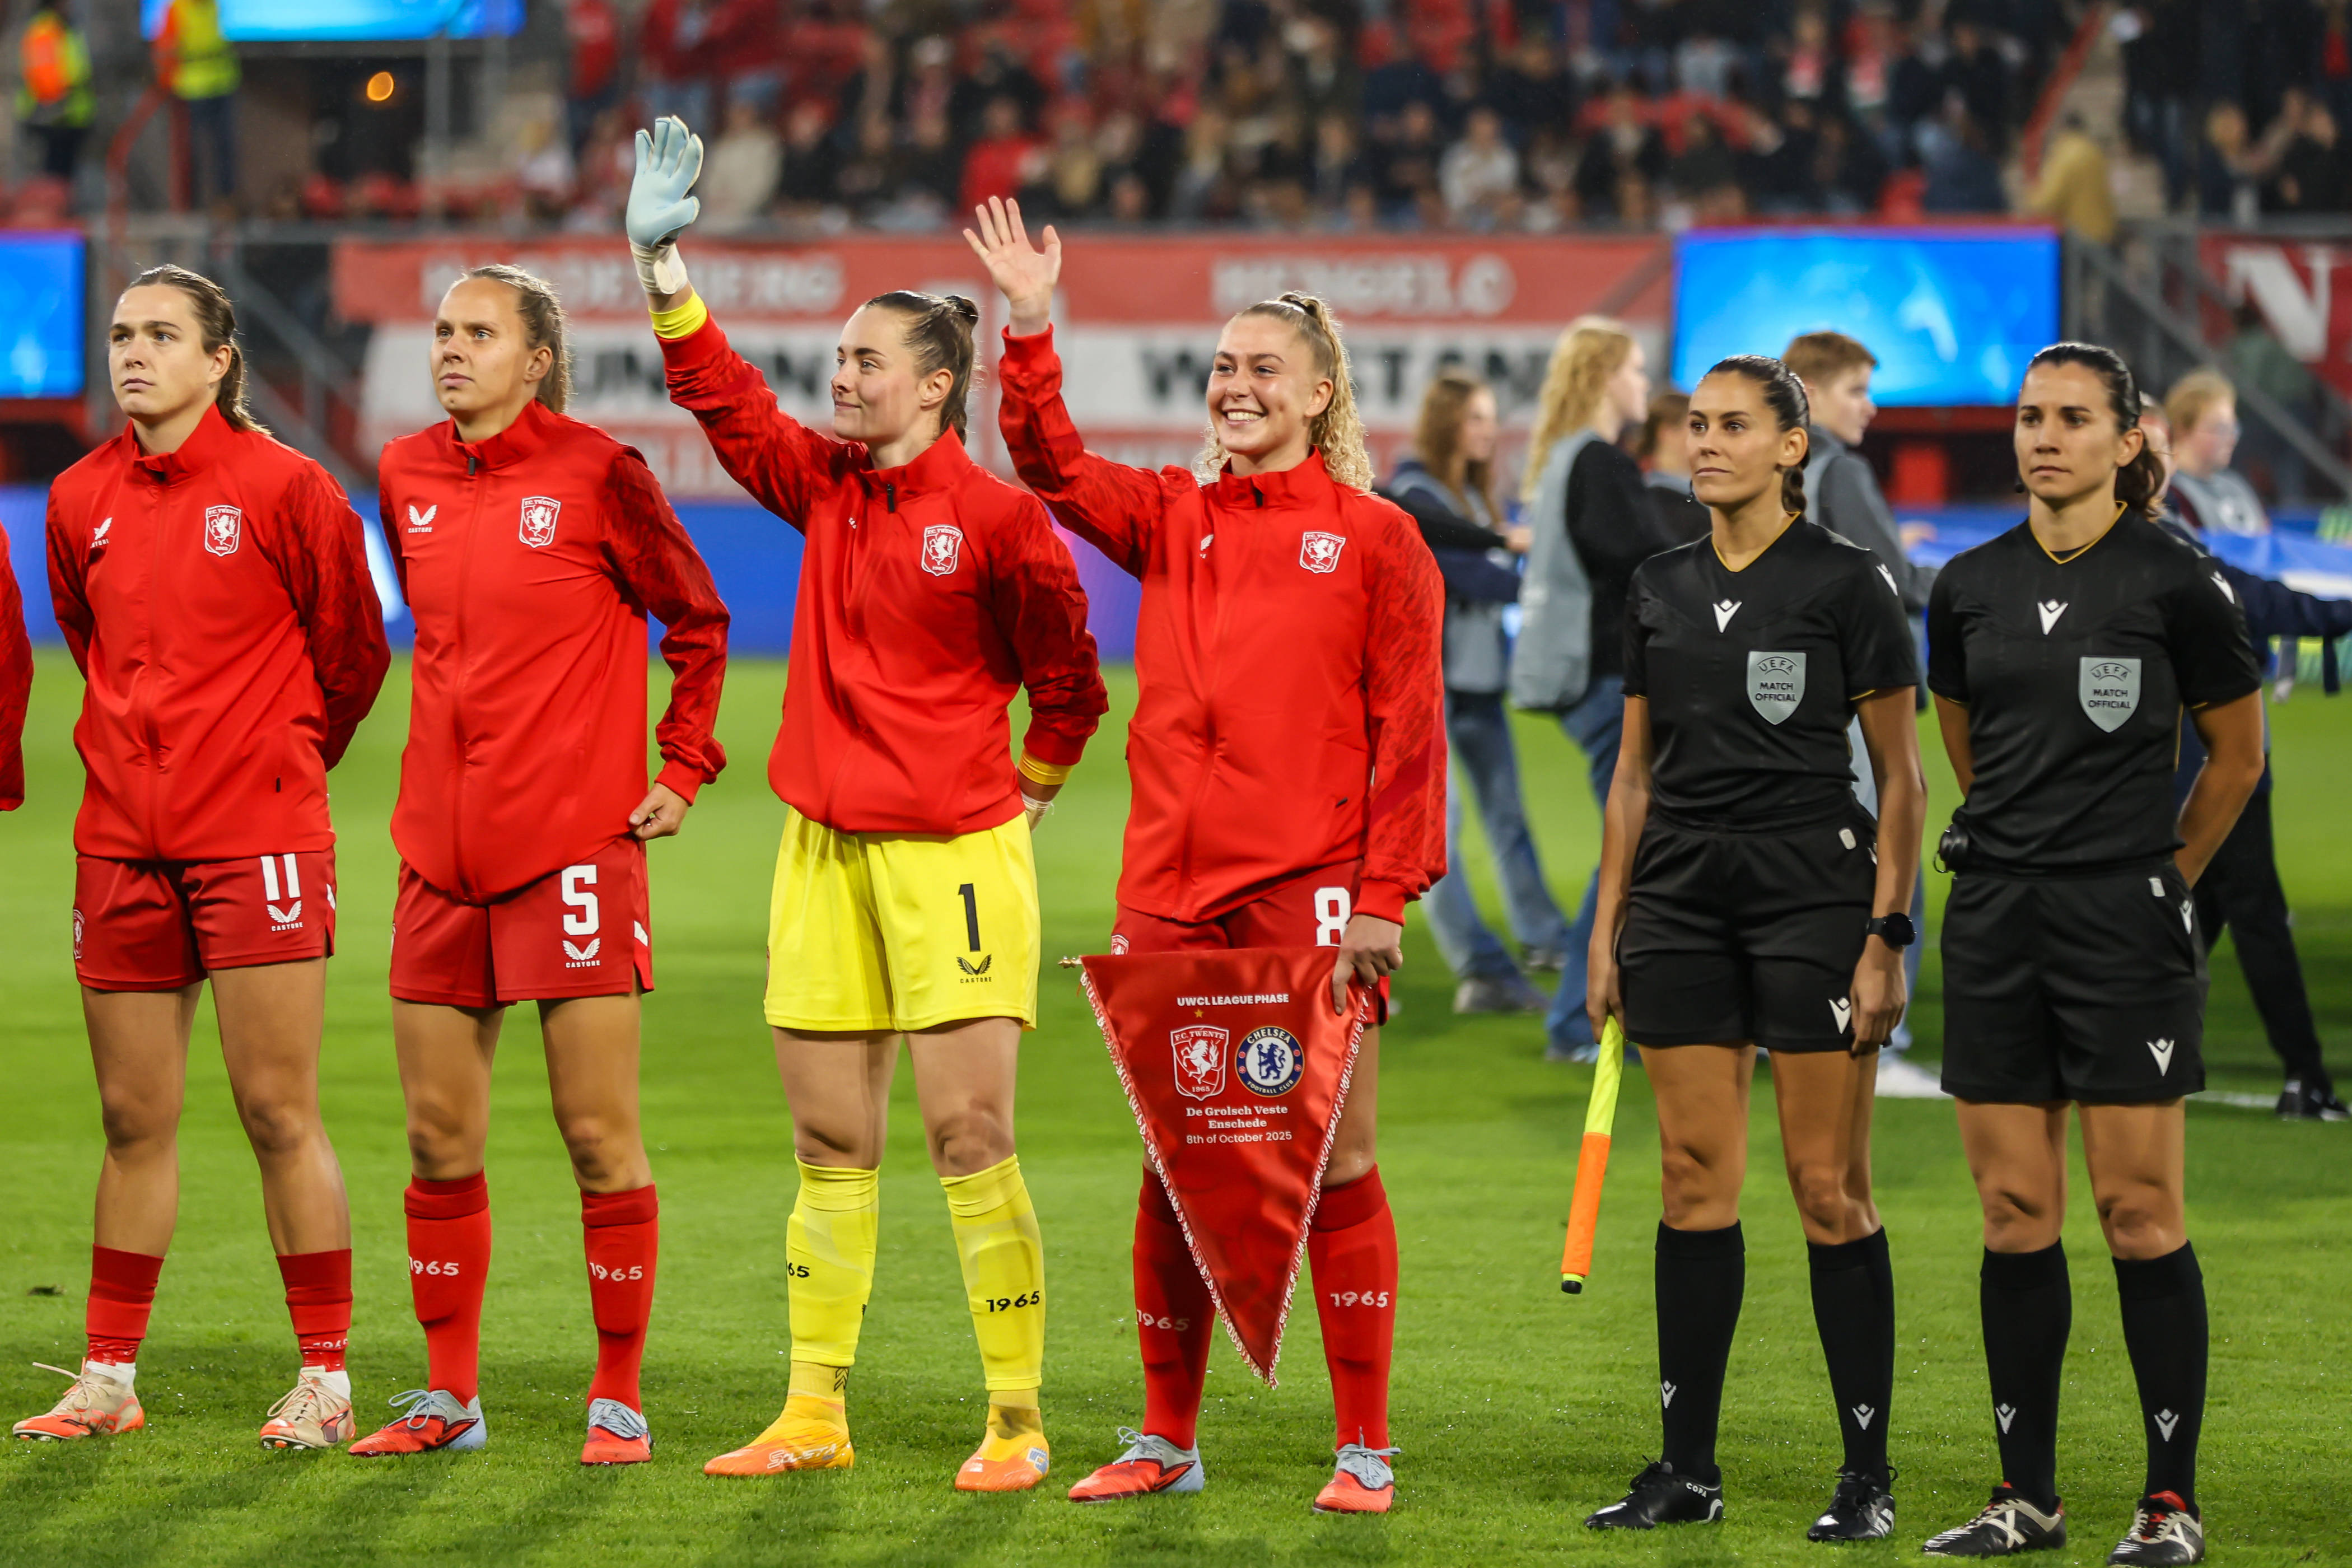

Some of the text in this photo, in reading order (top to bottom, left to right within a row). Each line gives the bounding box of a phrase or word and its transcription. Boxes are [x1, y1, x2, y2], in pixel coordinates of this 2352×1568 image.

[1758, 659, 1794, 673] UEFA
[2092, 665, 2128, 679] UEFA
[1760, 682, 1794, 690] MATCH
[2093, 689, 2128, 697] MATCH
[1755, 693, 1797, 702] OFFICIAL
[2088, 700, 2131, 709] OFFICIAL
[260, 853, 301, 901] 11
[561, 864, 600, 936] 5
[958, 883, 981, 952] 1
[1314, 886, 1351, 947] 8
[271, 921, 303, 932] CASTORE
[566, 960, 600, 968] CASTORE
[1177, 994, 1289, 1007] UWCL LEAGUE PHASE
[1174, 1030, 1226, 1041] F.C. TWENTE
[1247, 1028, 1291, 1044] CHELSEA
[1247, 1079, 1294, 1094] FOOTBALL CLUB
[1186, 1105, 1289, 1117] De Grolsch Veste
[1208, 1118, 1267, 1129] Enschede
[1186, 1131, 1292, 1144] 8th of October 2025
[408, 1256, 459, 1276] 1965
[590, 1262, 643, 1281] 1965
[786, 1262, 810, 1278] 65
[986, 1290, 1040, 1313] 1965
[1330, 1291, 1389, 1308] 1965
[1136, 1309, 1190, 1332] 1965
[1686, 1482, 1707, 1498] COPA
